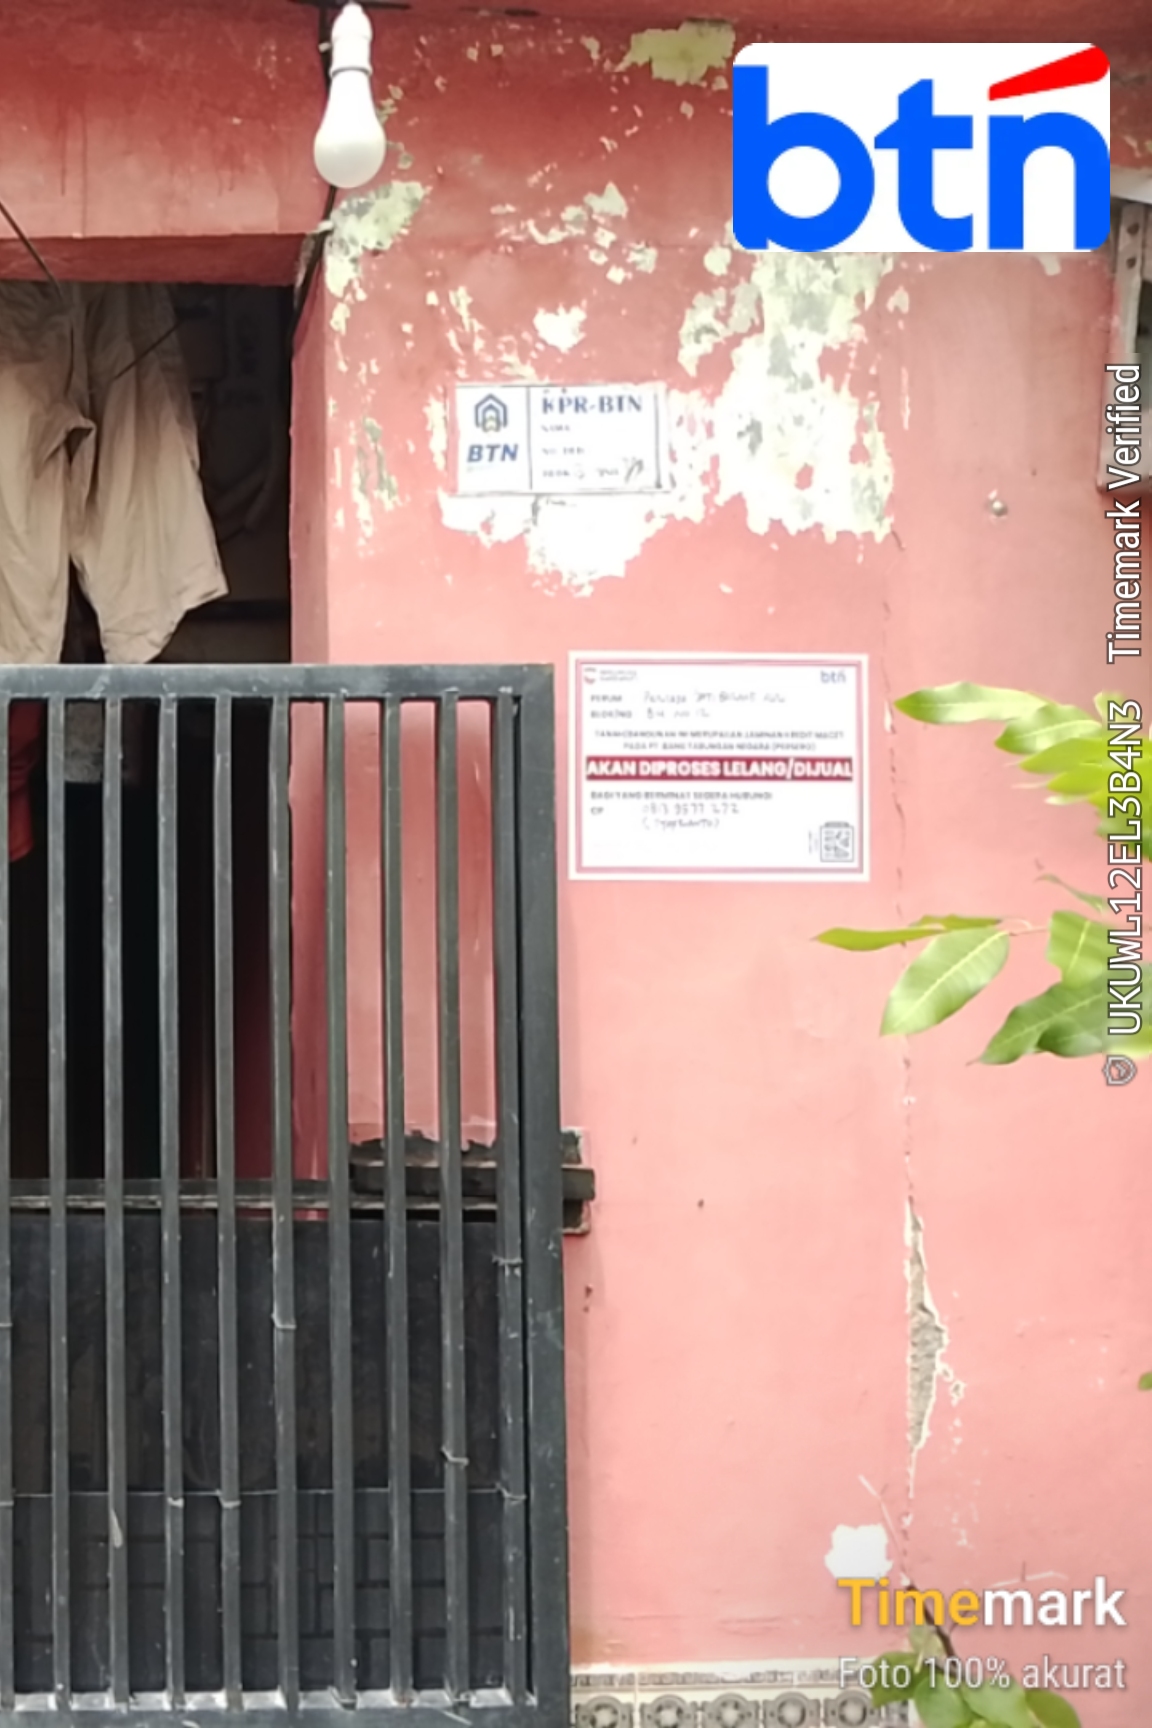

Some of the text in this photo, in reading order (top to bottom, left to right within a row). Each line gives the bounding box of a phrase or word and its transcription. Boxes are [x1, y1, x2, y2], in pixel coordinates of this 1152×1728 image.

[467, 443, 519, 463] BTN
[588, 758, 853, 779] AKAN DIPROSES LELANG/DIJUAL
